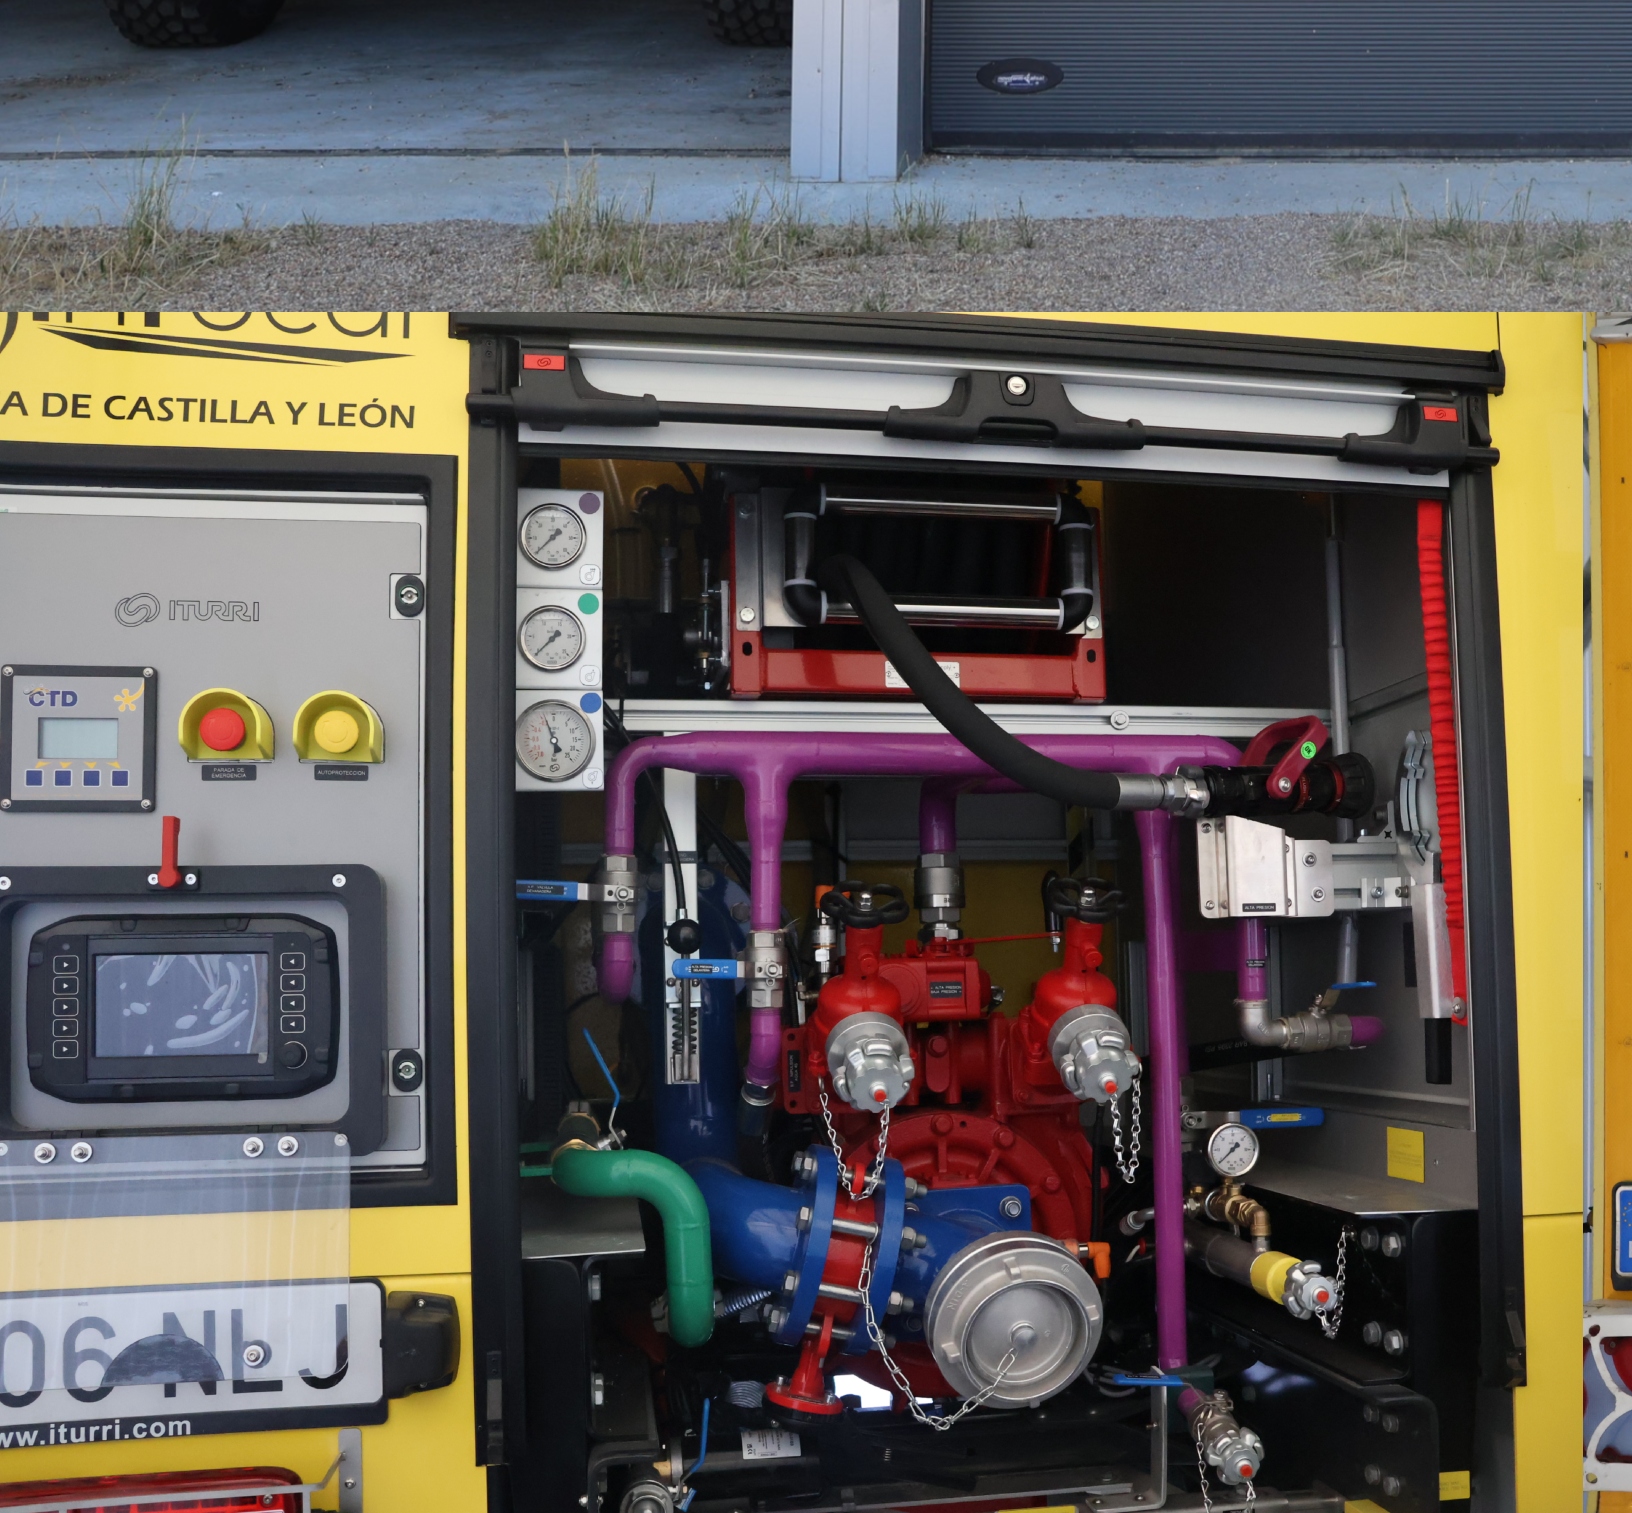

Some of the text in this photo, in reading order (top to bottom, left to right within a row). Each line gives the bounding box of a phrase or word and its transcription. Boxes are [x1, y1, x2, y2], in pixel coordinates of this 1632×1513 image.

[42, 392, 92, 419] DE
[103, 395, 275, 425] CASTILLA
[286, 401, 308, 426] Y
[318, 398, 416, 429] LEÓN
[168, 600, 260, 622] ITURRI
[28, 690, 78, 707] CTD
